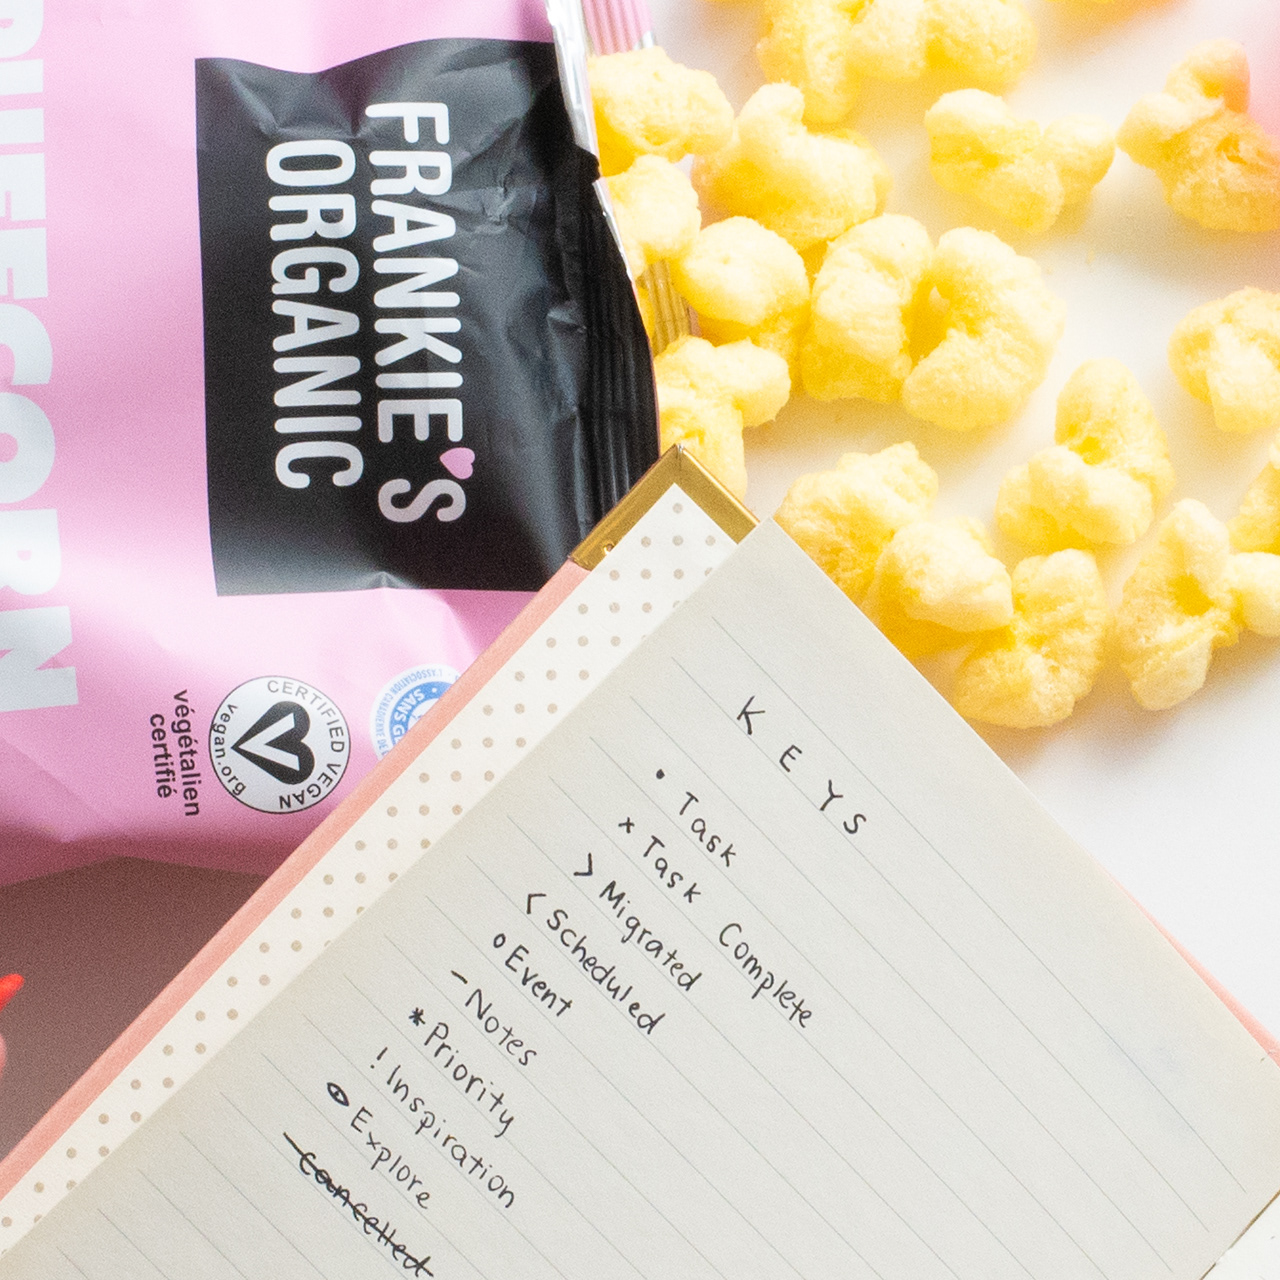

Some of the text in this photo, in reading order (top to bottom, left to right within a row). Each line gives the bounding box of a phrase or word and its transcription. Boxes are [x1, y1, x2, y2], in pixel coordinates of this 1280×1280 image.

[265, 139, 364, 489] ORGANIC
[365, 101, 476, 523] FRANKIE'S
[150, 713, 178, 798] certifié
[171, 689, 201, 816] végétalien
[213, 703, 247, 797] vegan.org
[267, 680, 345, 809] CERTIFIED VEGAN
[393, 688, 425, 723] SANS
[736, 695, 867, 835] KEYS
[678, 790, 736, 867] Task
[505, 944, 573, 1017] Event
[546, 909, 666, 1035] Scheduled
[599, 880, 703, 991] Migrated
[643, 835, 701, 903] Task
[719, 923, 812, 1028] Complete
[423, 1022, 514, 1138] Priority
[465, 988, 537, 1066] Notes
[350, 1106, 431, 1209] Explore
[386, 1064, 516, 1208] Inspiration
